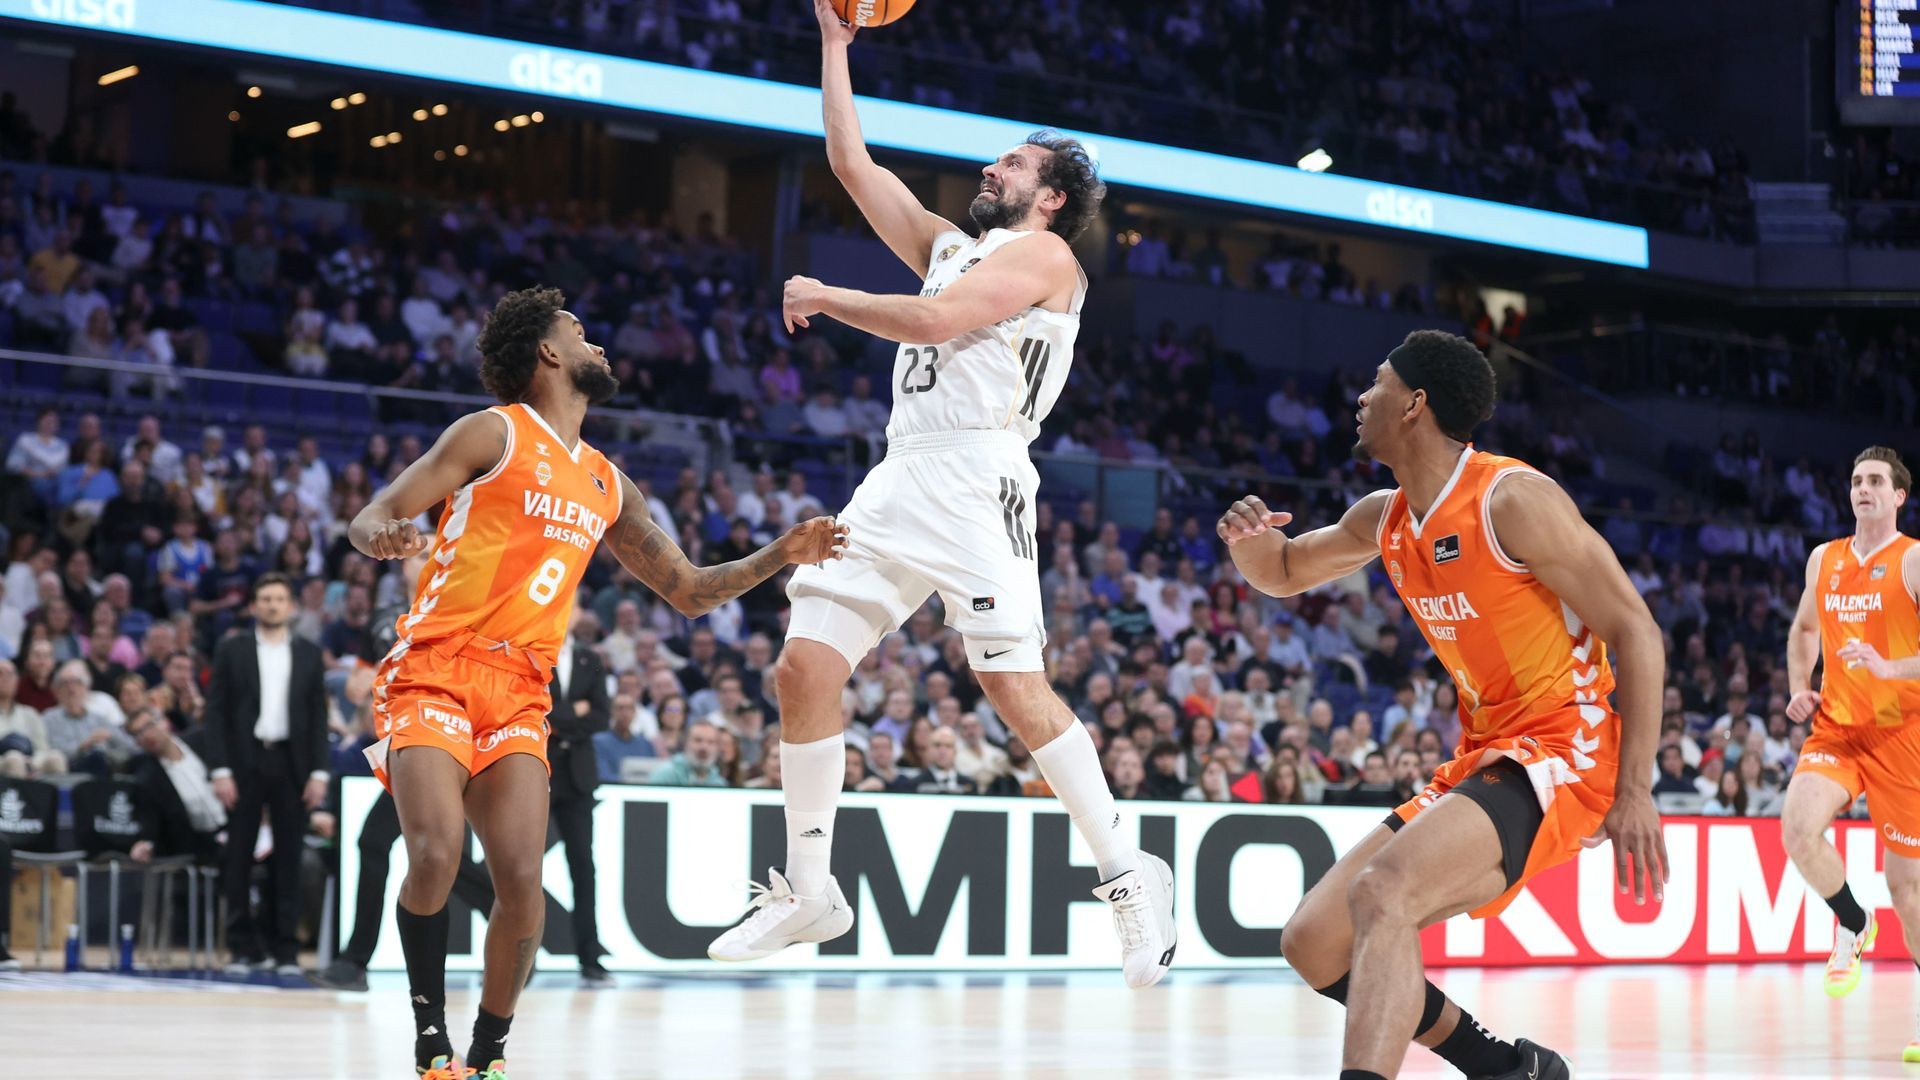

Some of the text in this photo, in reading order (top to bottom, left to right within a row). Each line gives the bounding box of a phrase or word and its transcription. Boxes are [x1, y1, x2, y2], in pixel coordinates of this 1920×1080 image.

[509, 48, 604, 97] alsa
[1366, 187, 1434, 228] alsa
[901, 346, 938, 394] 23
[543, 524, 591, 551] BASKET
[528, 558, 566, 606] 8
[1825, 592, 1882, 612] VALENCIA
[1838, 611, 1867, 623] BASKET
[424, 707, 472, 734] PULEVA
[482, 726, 540, 750] Midea
